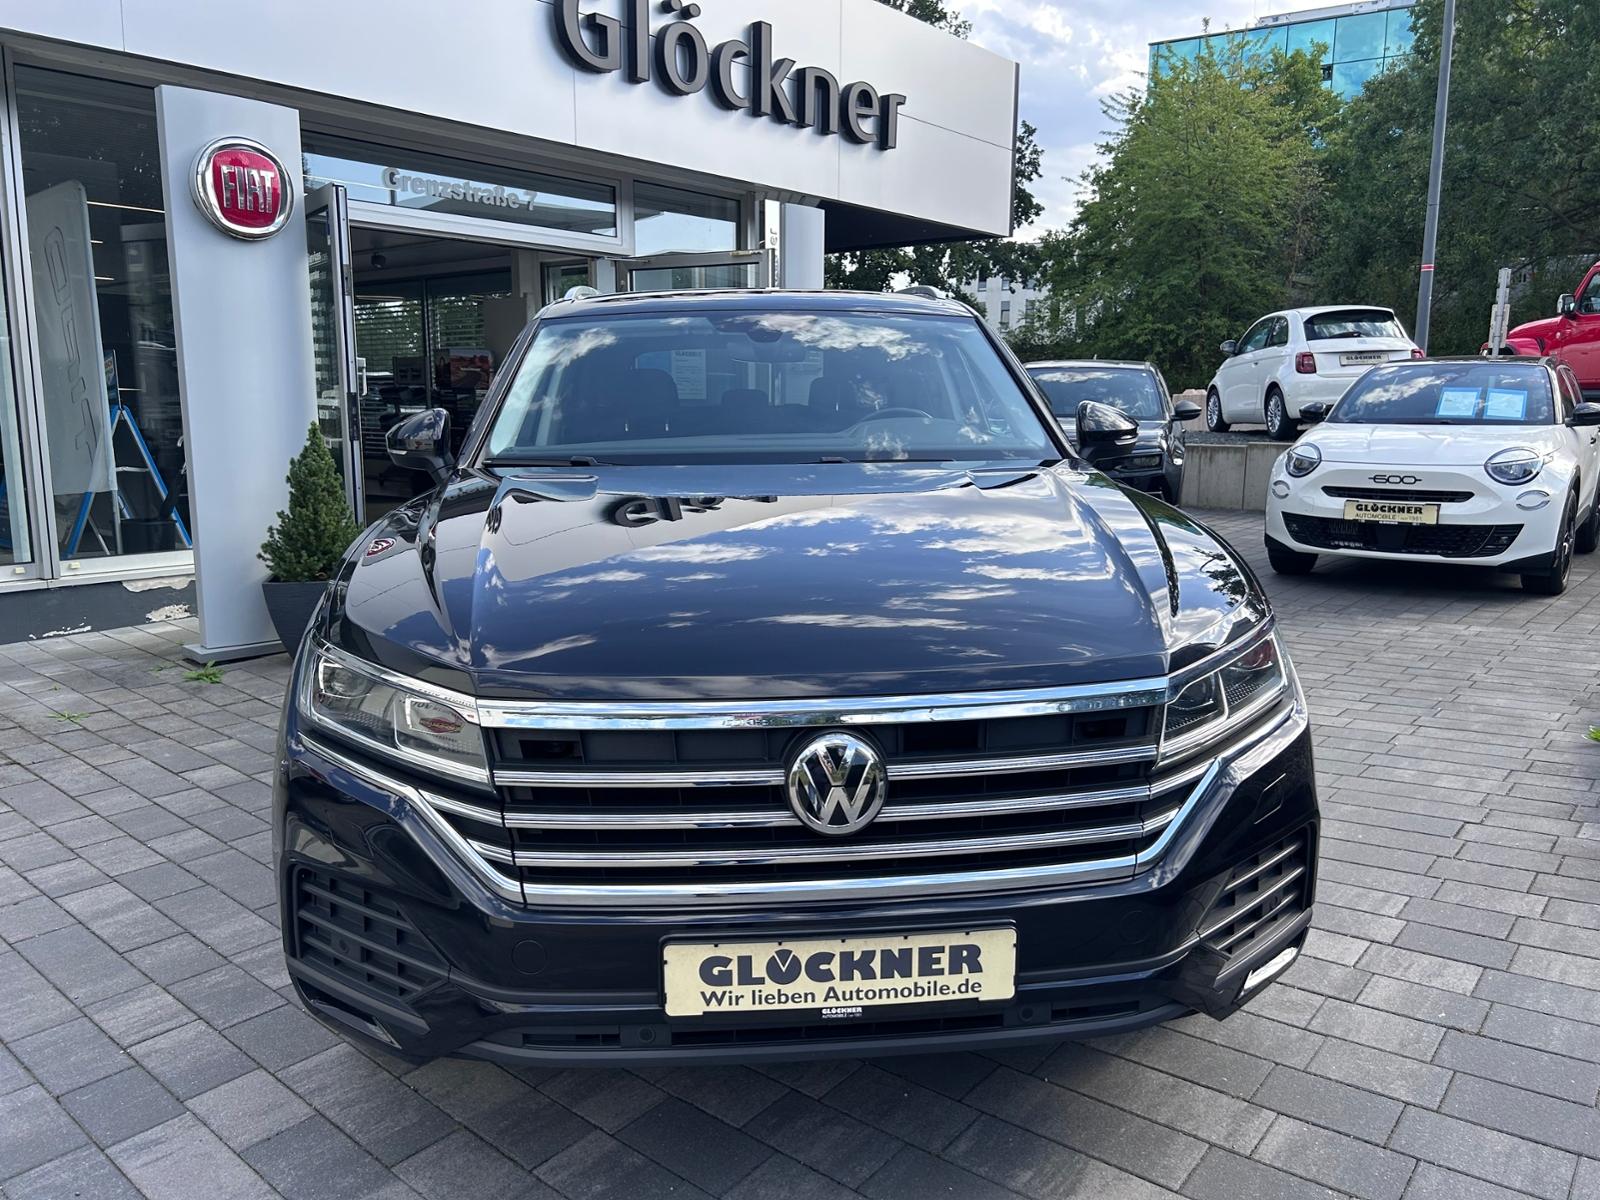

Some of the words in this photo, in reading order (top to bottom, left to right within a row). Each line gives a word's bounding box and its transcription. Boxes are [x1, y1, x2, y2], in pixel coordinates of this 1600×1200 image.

[553, 0, 906, 150] Glöckner
[221, 165, 275, 213] FIAT
[382, 167, 519, 209] Grenzstraße
[524, 189, 538, 211] 7
[1369, 474, 1421, 485] 600
[700, 989, 745, 1007] Wir
[751, 988, 816, 1005] lieben
[823, 978, 983, 1002] Automobile.de
